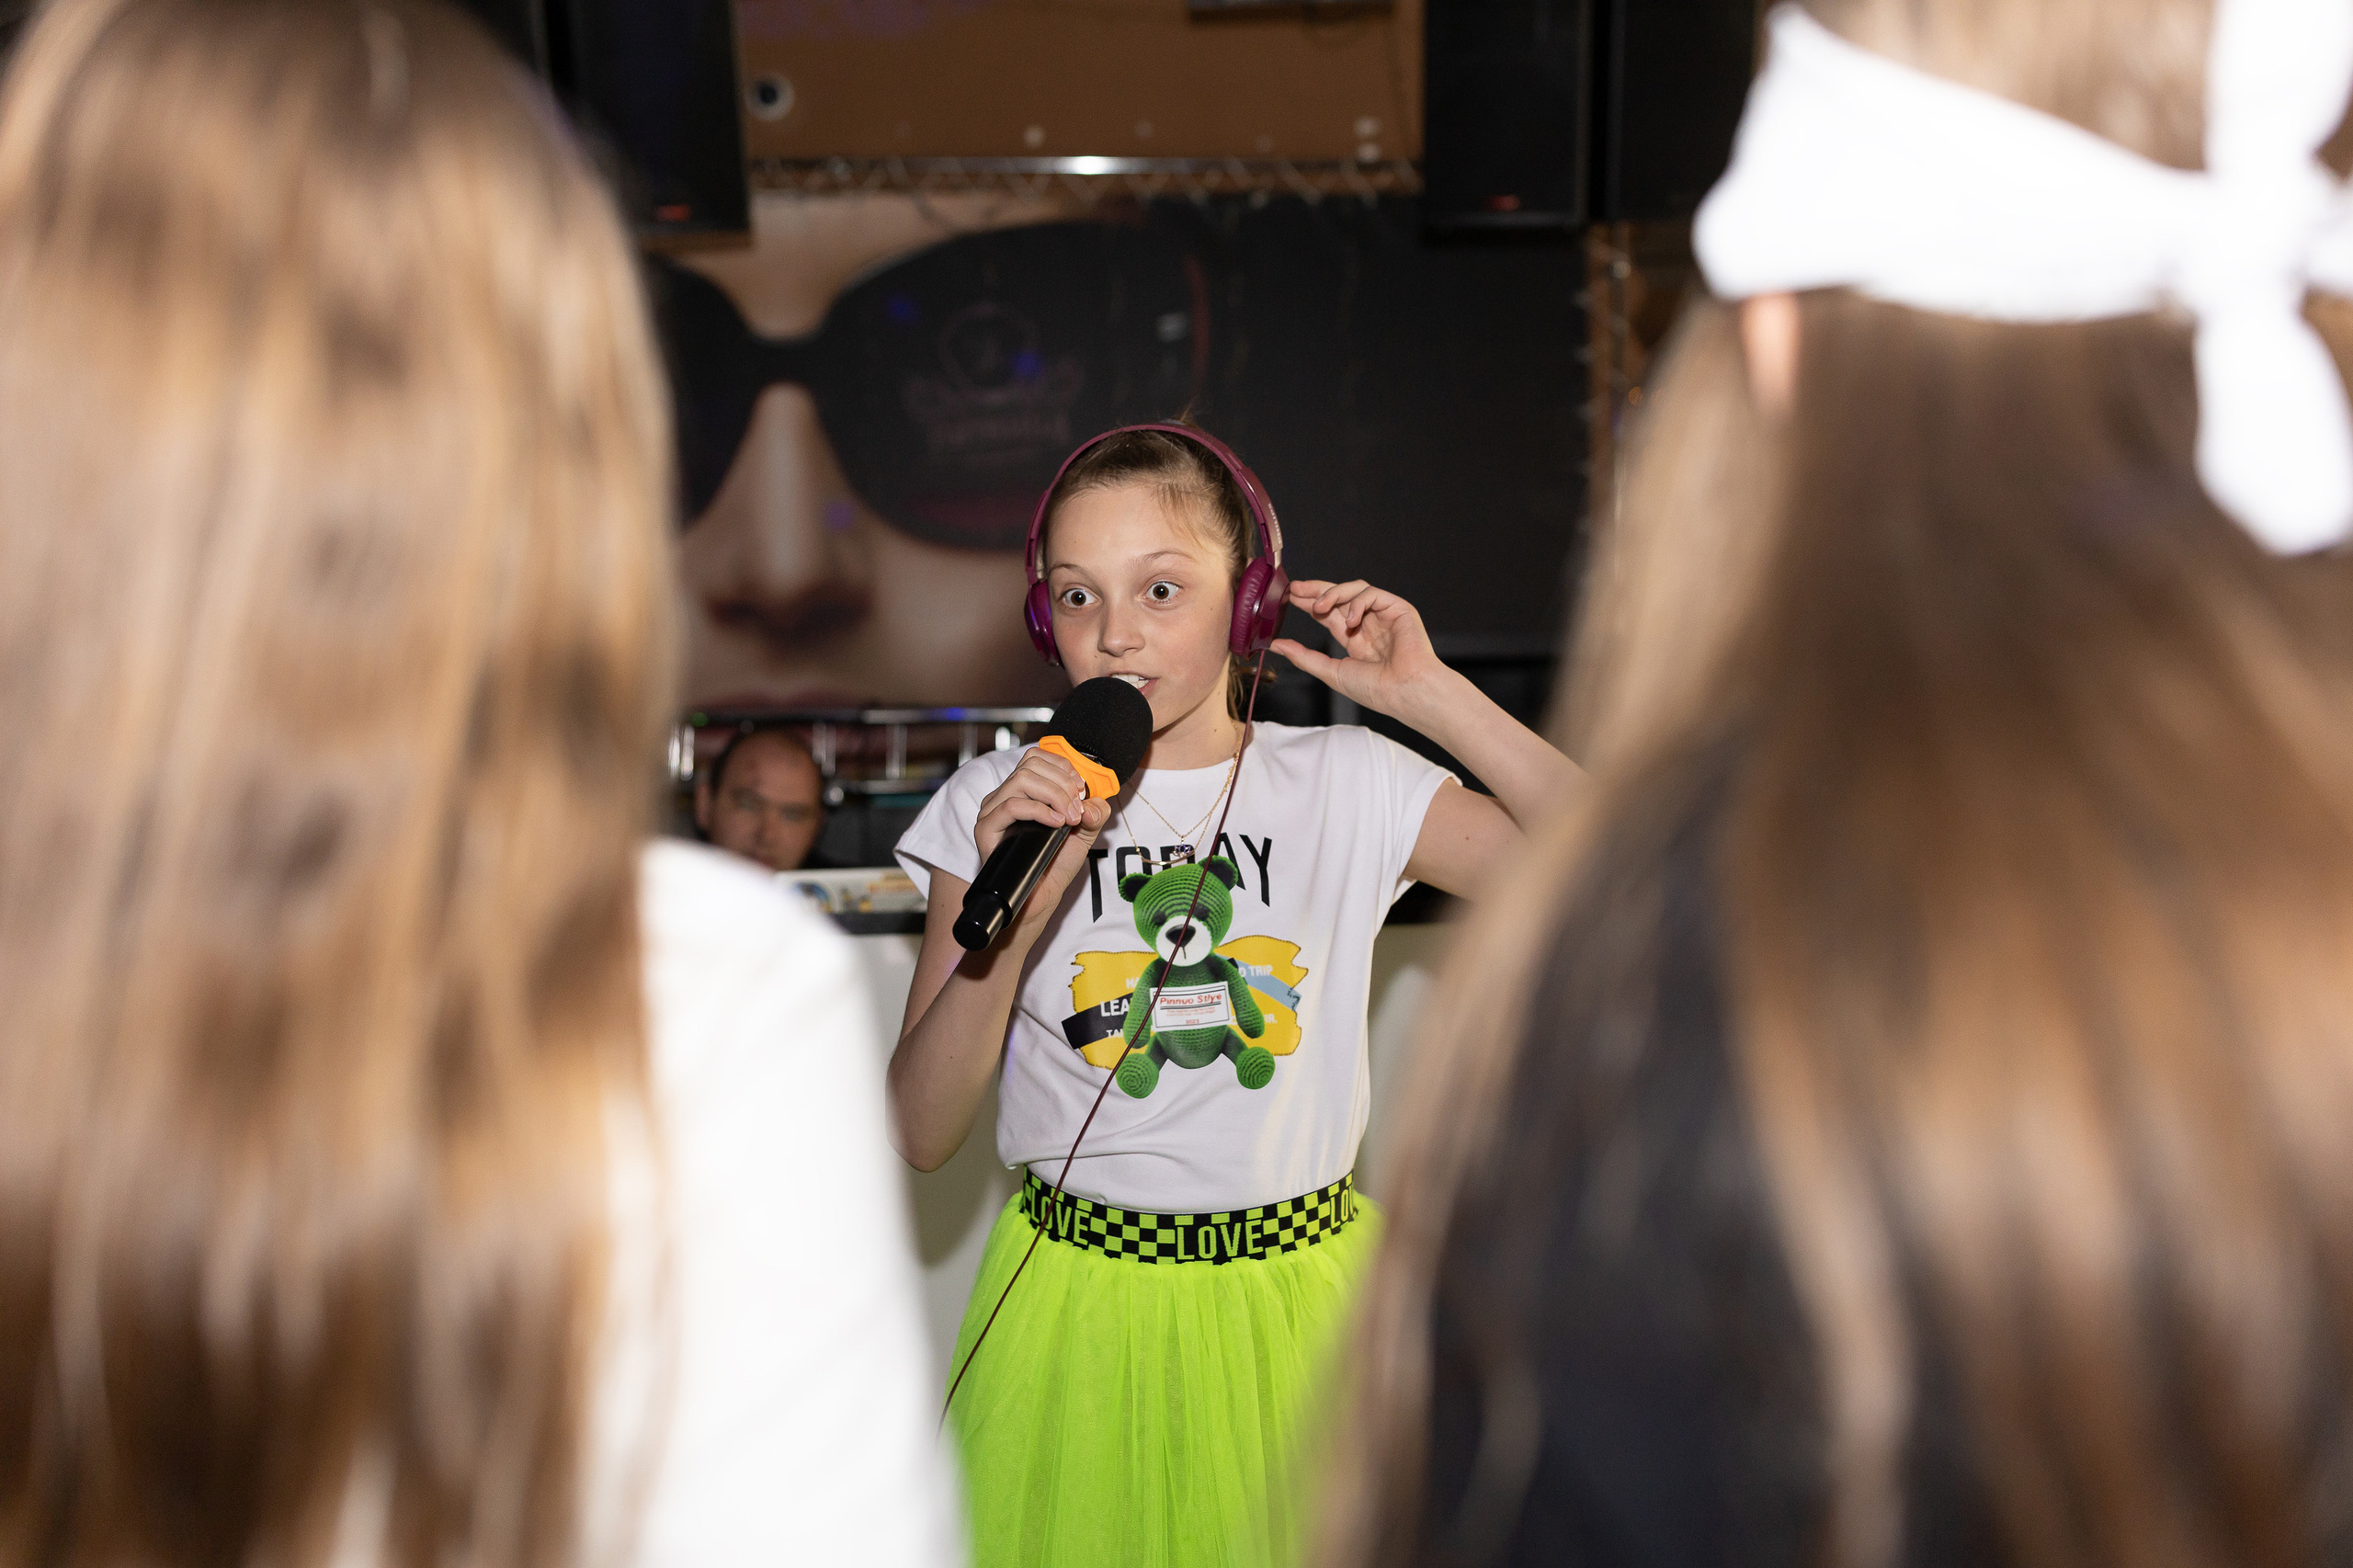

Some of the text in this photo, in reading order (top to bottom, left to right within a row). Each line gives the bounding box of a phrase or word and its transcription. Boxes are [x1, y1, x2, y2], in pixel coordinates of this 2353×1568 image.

[1248, 964, 1273, 977] TRIP
[1100, 998, 1132, 1017] LEA
[1159, 996, 1195, 1005] Pinnuo
[1031, 1187, 1090, 1245] LOVE
[1176, 1219, 1264, 1260] LOVE
